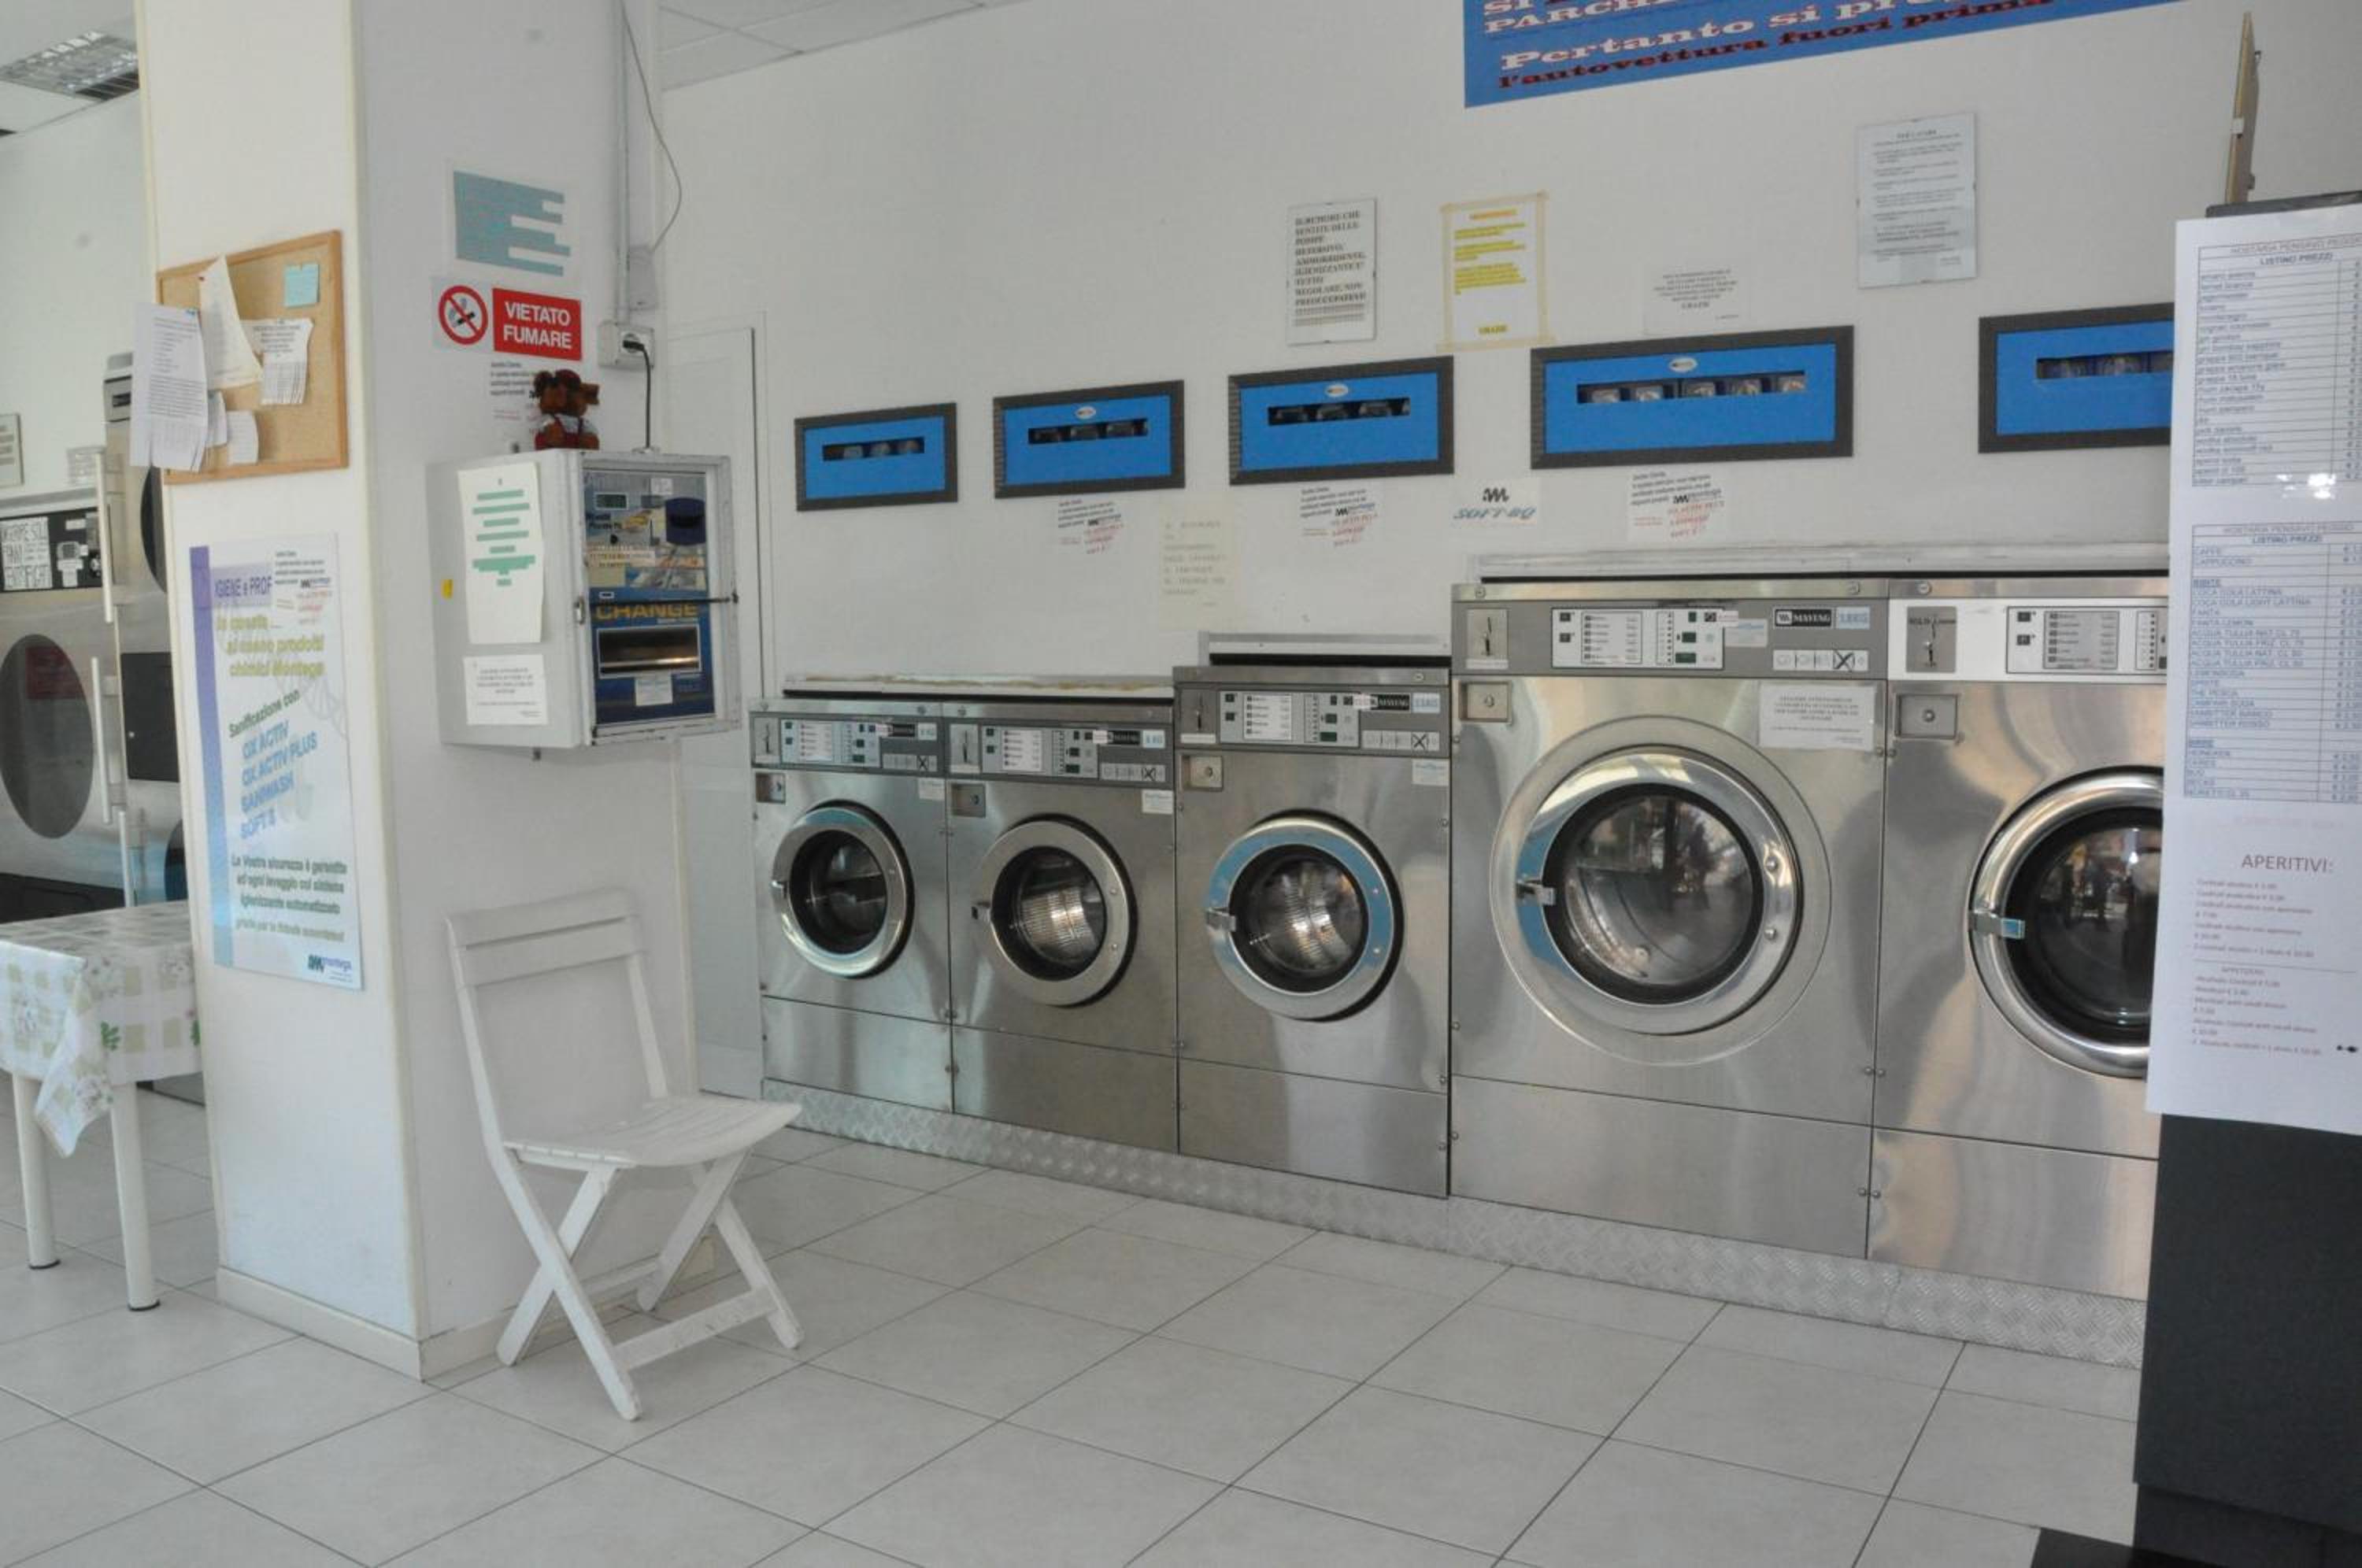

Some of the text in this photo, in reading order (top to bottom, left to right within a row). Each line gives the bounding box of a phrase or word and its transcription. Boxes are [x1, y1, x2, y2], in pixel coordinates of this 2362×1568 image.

[1501, 6, 1820, 71] Pertanto si
[1498, 39, 1768, 89] l'autovettura
[1779, 17, 1893, 46] fuori
[2260, 252, 2334, 265] LISTINO PREZZI
[505, 301, 572, 327] VIETATO
[503, 324, 573, 349] FUMARE
[2252, 534, 2323, 544] LISTINO PREZZI
[214, 578, 242, 598] IGIENE
[596, 603, 700, 620] CHANGE
[228, 689, 301, 738] Sanificazione con
[2241, 852, 2335, 874] APERITIVI:
